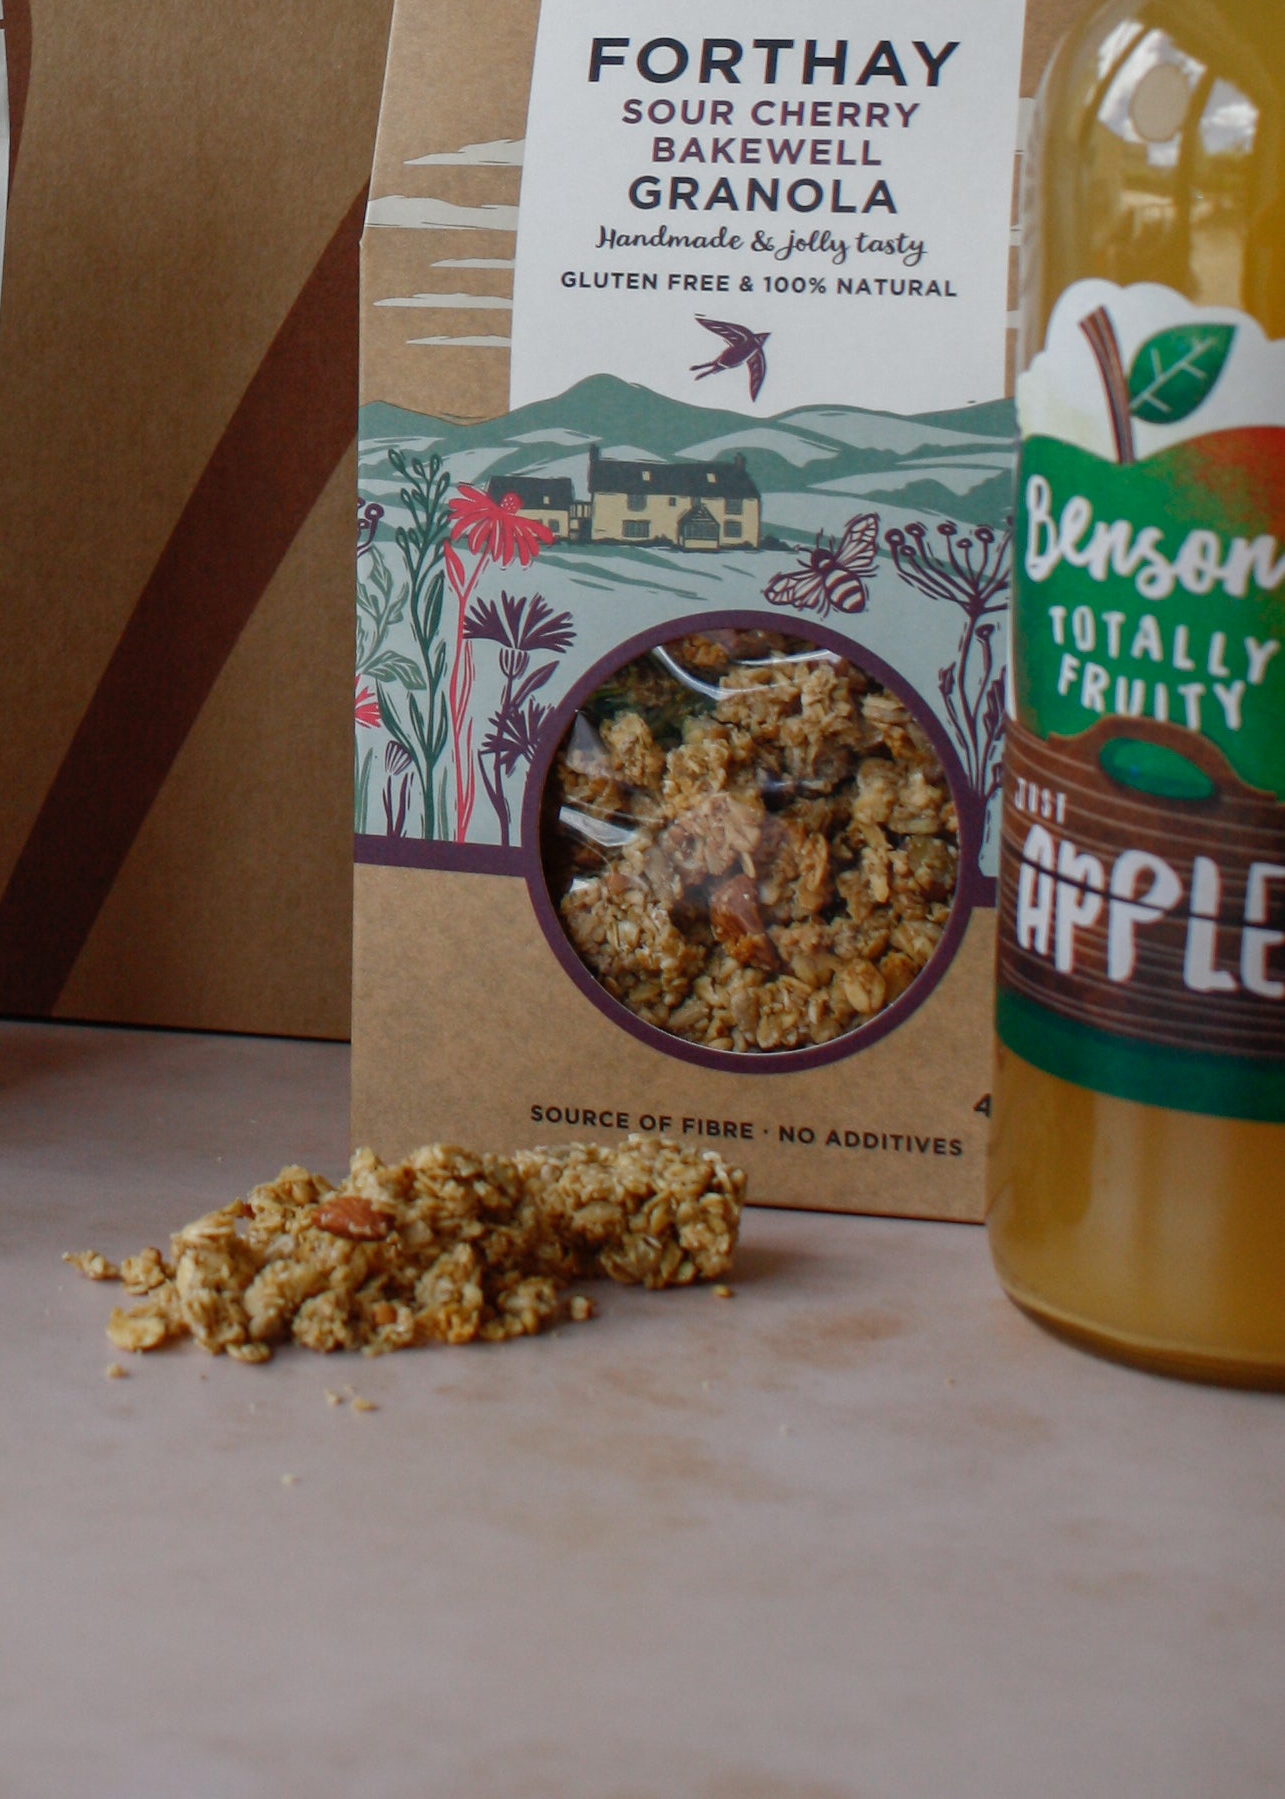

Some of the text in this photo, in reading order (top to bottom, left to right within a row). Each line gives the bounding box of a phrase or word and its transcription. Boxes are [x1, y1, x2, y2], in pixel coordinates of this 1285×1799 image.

[587, 37, 962, 88] FORTHAY
[621, 98, 921, 128] SOUR CHERRY
[651, 136, 883, 166] BAKEWELL
[628, 175, 898, 214] GRANOLA
[594, 224, 929, 267] Handmade & jolly tasty
[560, 271, 958, 298] GLUTEN FREE & 100% NATURAL
[1024, 474, 1285, 600] Benson
[1048, 604, 1282, 685] TOTALLY
[1058, 653, 1246, 731] FRUITY
[1014, 777, 1067, 825] JUST
[1016, 824, 1285, 1000] APPLE
[530, 1104, 964, 1157] SOURCE OF FIBRE NO ADDITIVES
